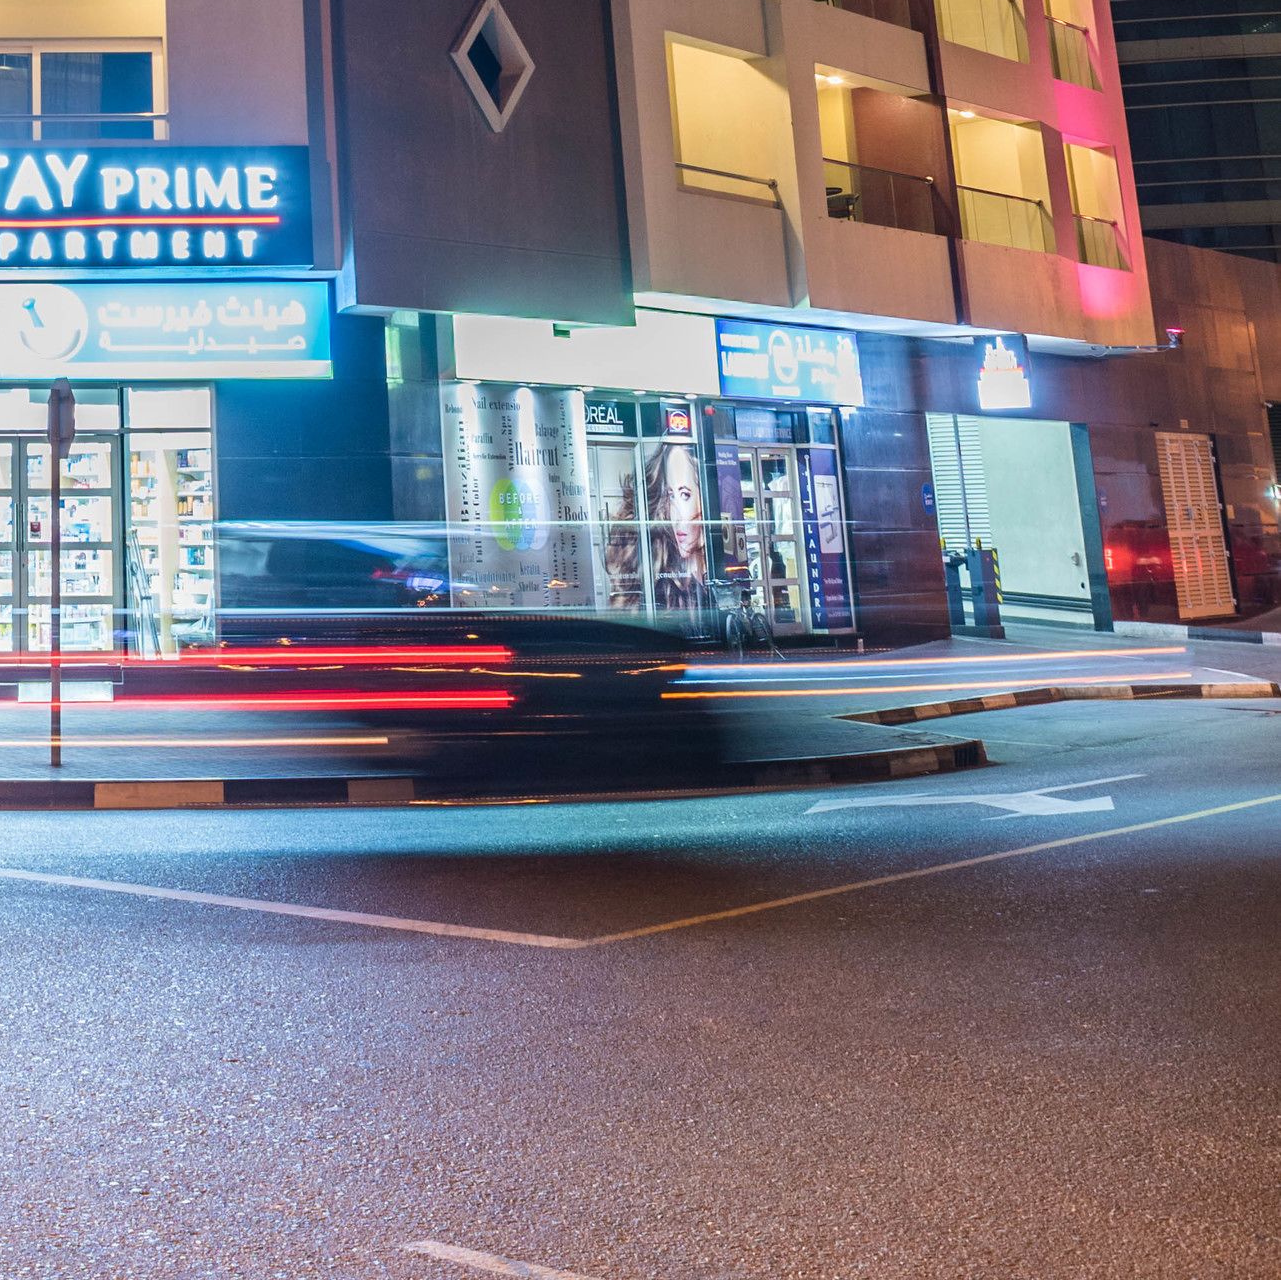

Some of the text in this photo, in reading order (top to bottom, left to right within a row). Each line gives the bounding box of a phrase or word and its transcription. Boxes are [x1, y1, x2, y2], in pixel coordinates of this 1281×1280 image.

[99, 166, 280, 210] PRIME
[96, 295, 307, 333] هيلث فيرست
[98, 328, 307, 355] صيدلية
[488, 398, 521, 412] extensio
[515, 442, 560, 467] Haircut
[808, 524, 821, 622] LAUNDRY
